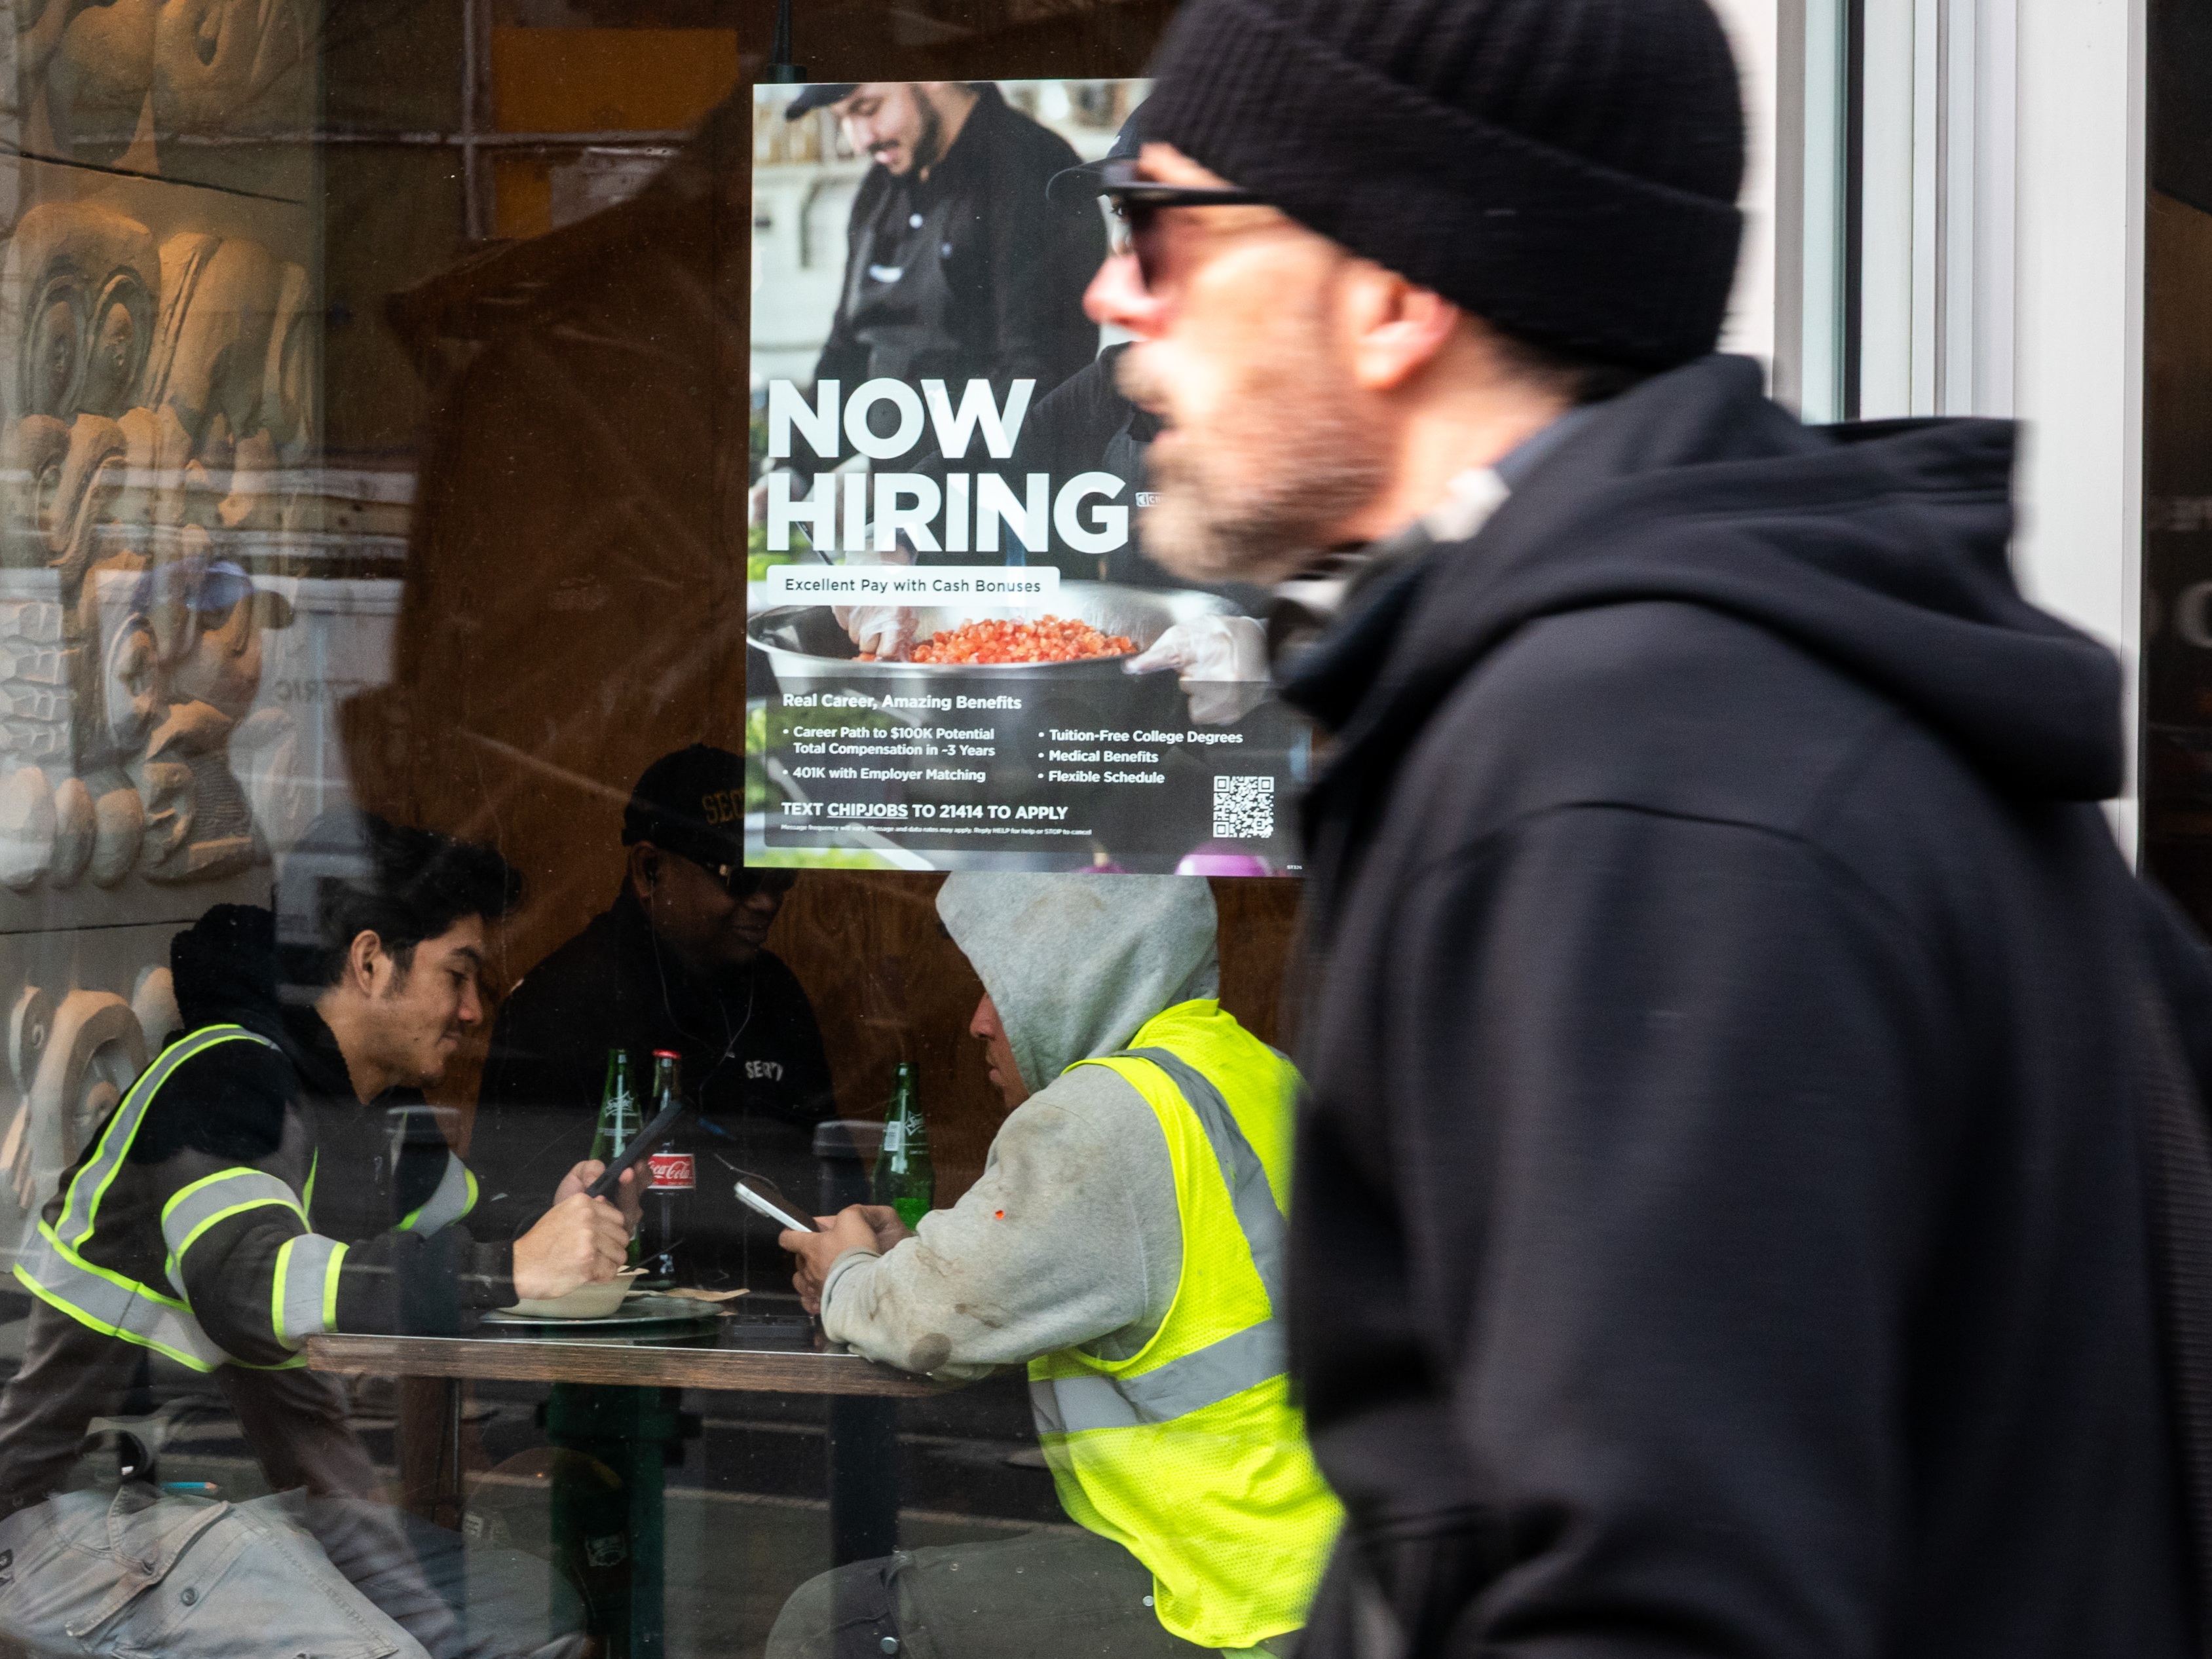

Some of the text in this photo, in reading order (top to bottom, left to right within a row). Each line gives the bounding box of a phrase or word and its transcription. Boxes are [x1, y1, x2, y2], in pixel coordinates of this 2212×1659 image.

[768, 377, 1037, 459] NOW
[766, 471, 1129, 554] HIRING
[786, 578, 1041, 593] Excellent Pay with Cash Bonuses
[783, 694, 1022, 711] Real Career, Amazing Benefits
[793, 726, 995, 740] Career Path to $100K Potential
[1049, 729, 1243, 745] Tuition-Free College Degrees
[794, 743, 996, 756] Total Compensation in ~3 Years
[1049, 750, 1159, 763] Medical Benefits
[793, 767, 986, 783] 401K with Employer Matching
[1049, 771, 1165, 783] Flexible Schedule
[781, 802, 1068, 819] TEXT CHIPJOBS TO 21414 TO APPLY
